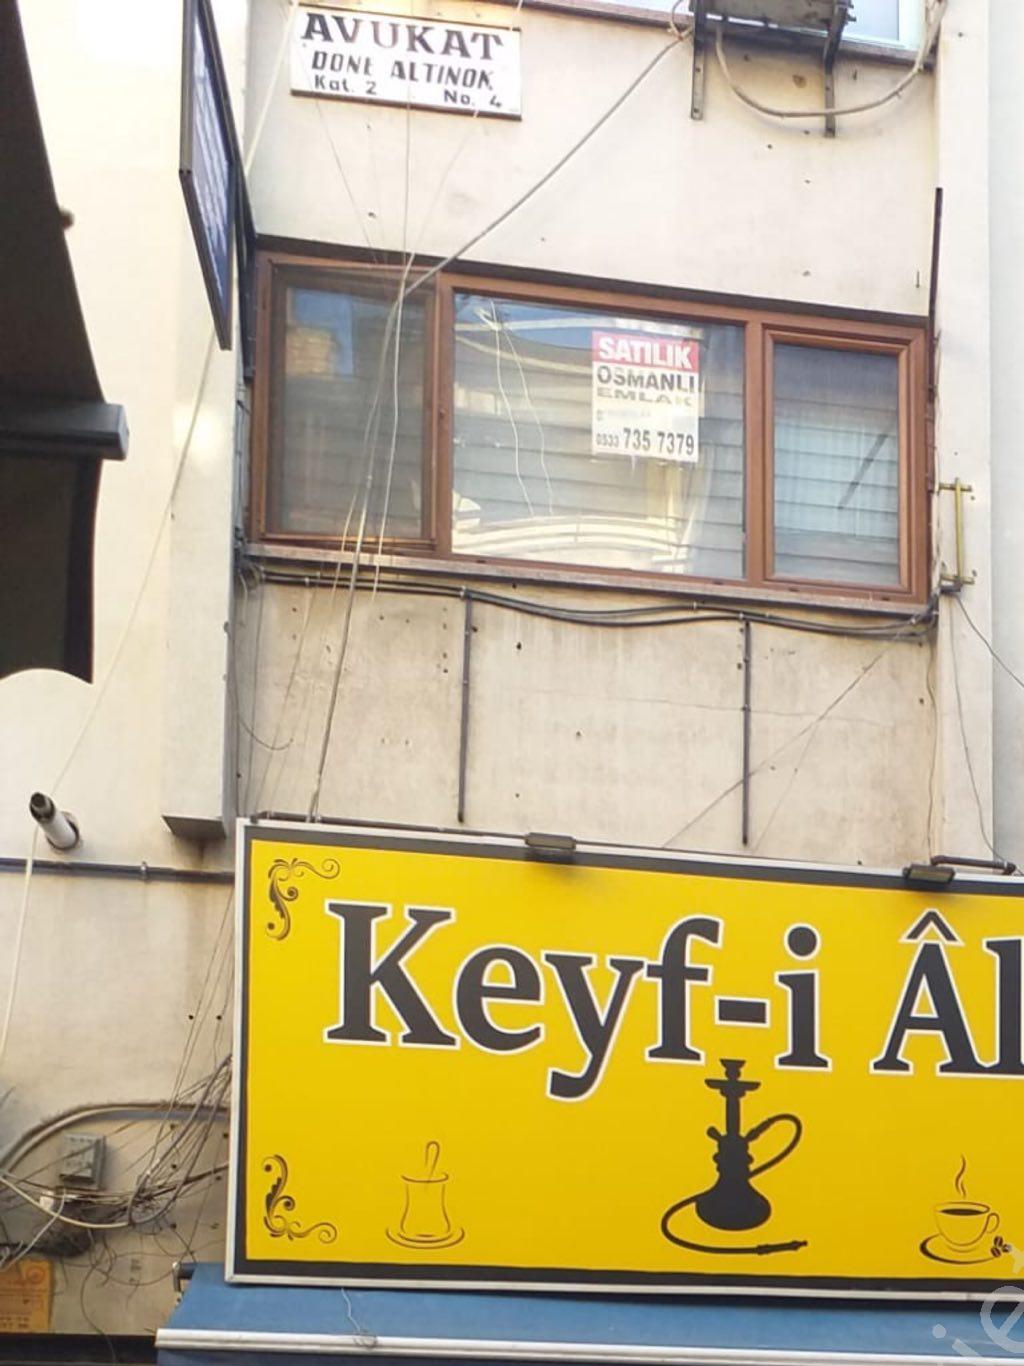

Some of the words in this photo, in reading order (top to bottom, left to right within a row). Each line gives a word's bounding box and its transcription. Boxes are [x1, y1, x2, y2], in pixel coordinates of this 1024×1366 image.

[301, 12, 504, 60] AVUKAT
[391, 60, 495, 91] ALTINOK
[366, 80, 377, 95] 2
[489, 95, 502, 108] 4
[599, 336, 693, 369] SATILIK
[597, 365, 695, 393] OSMANLI
[597, 387, 692, 407] EMLAK
[623, 427, 651, 452] 735
[657, 431, 694, 456] 7379
[324, 898, 831, 1102] Keyf-i
